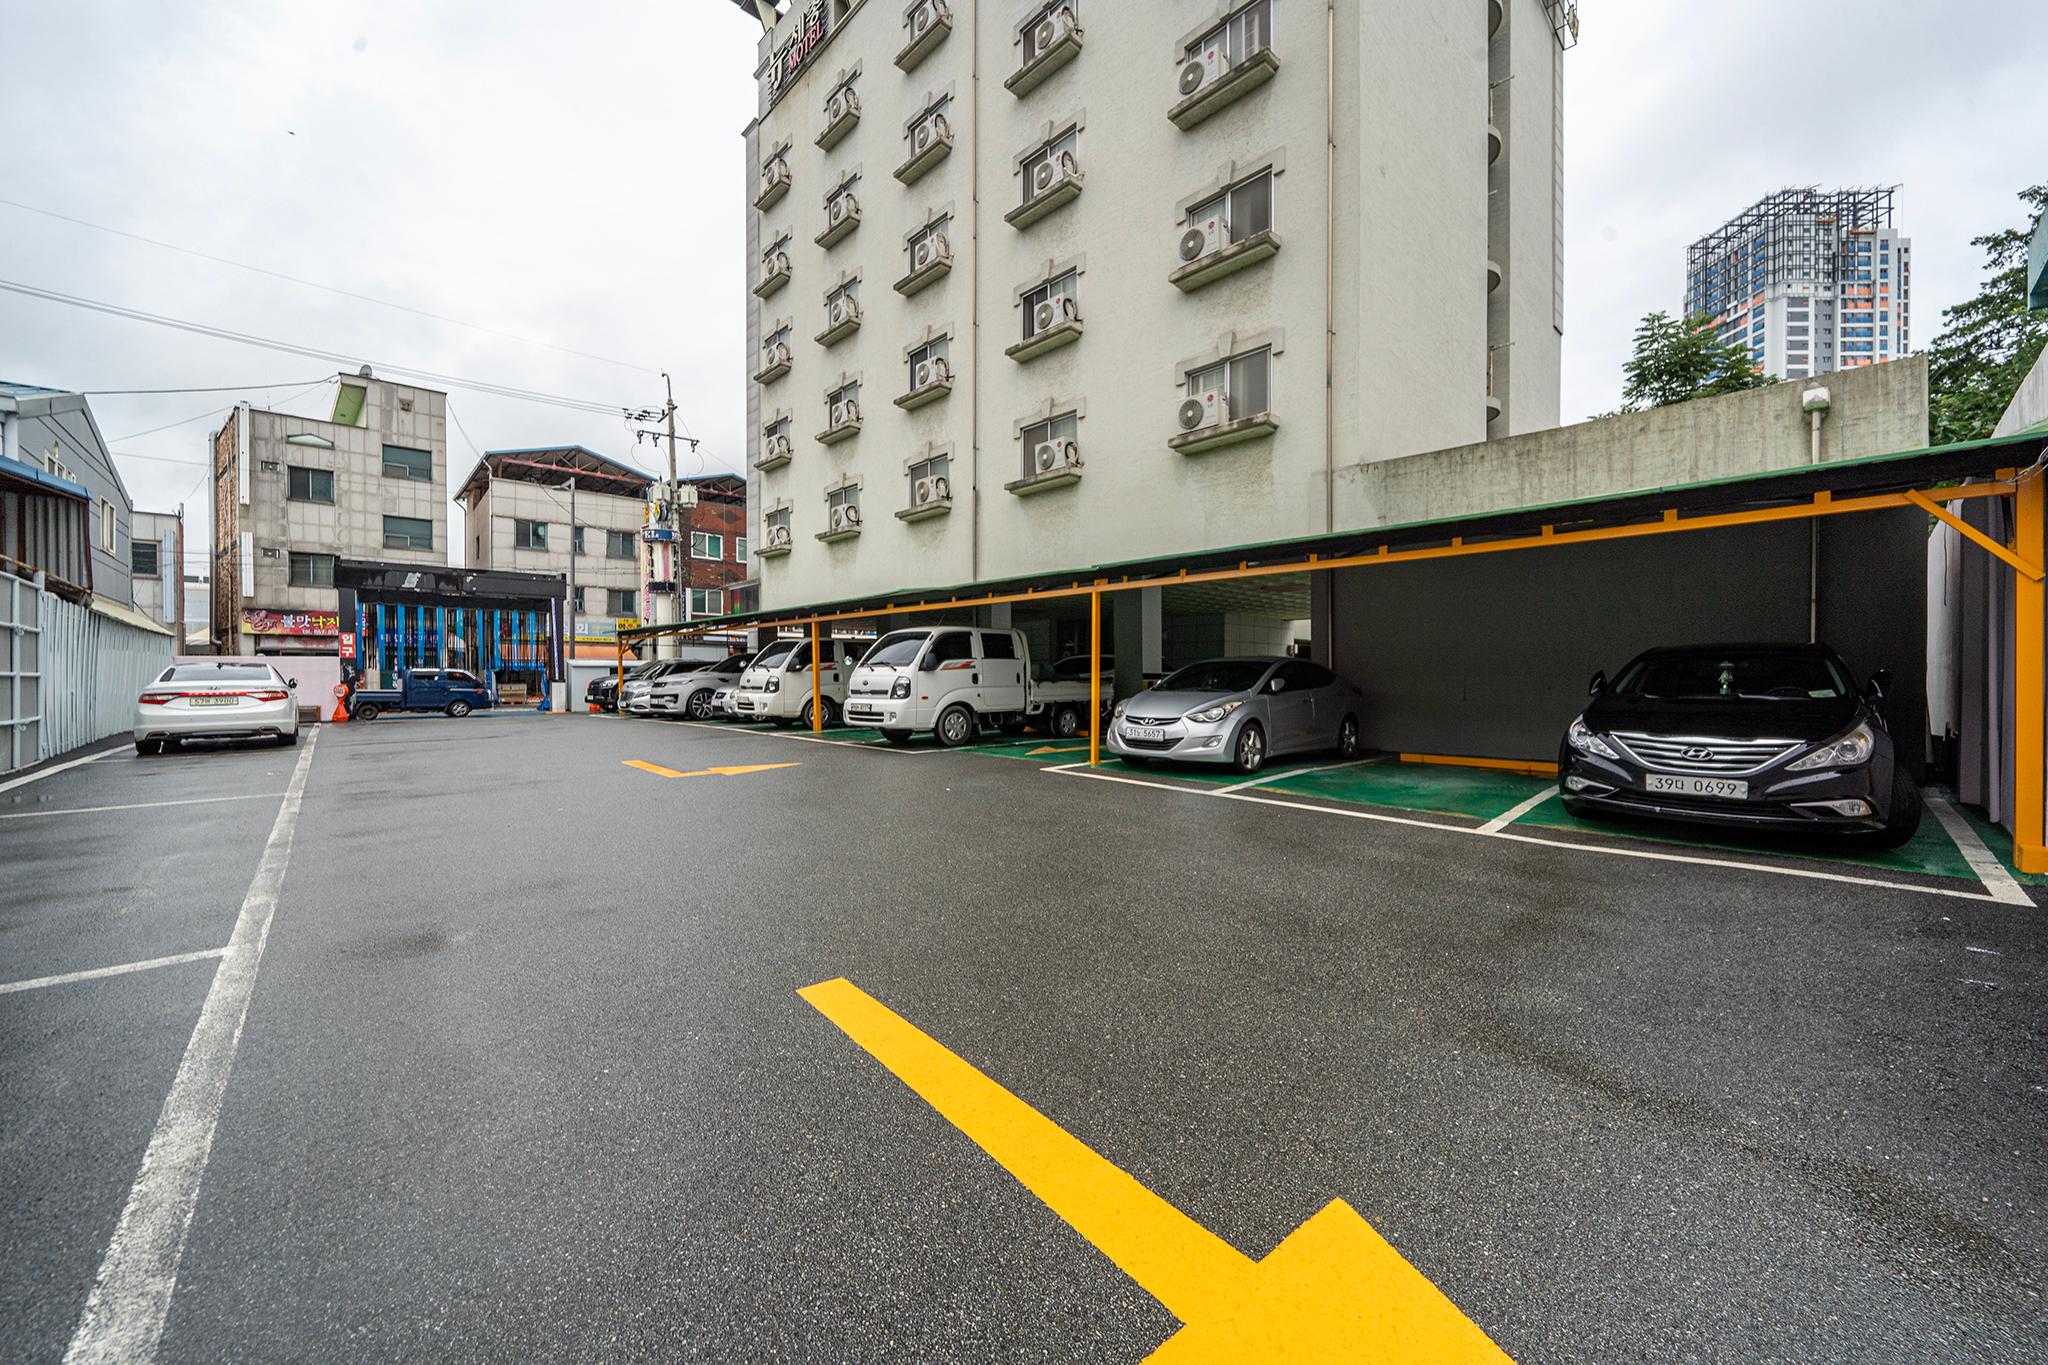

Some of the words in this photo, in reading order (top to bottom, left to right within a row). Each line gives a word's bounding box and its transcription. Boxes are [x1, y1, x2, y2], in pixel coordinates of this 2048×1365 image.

[788, 20, 823, 72] MOTEL
[341, 633, 354, 657] 입구
[1143, 729, 1161, 738] 5657
[1694, 780, 1737, 795] 0699
